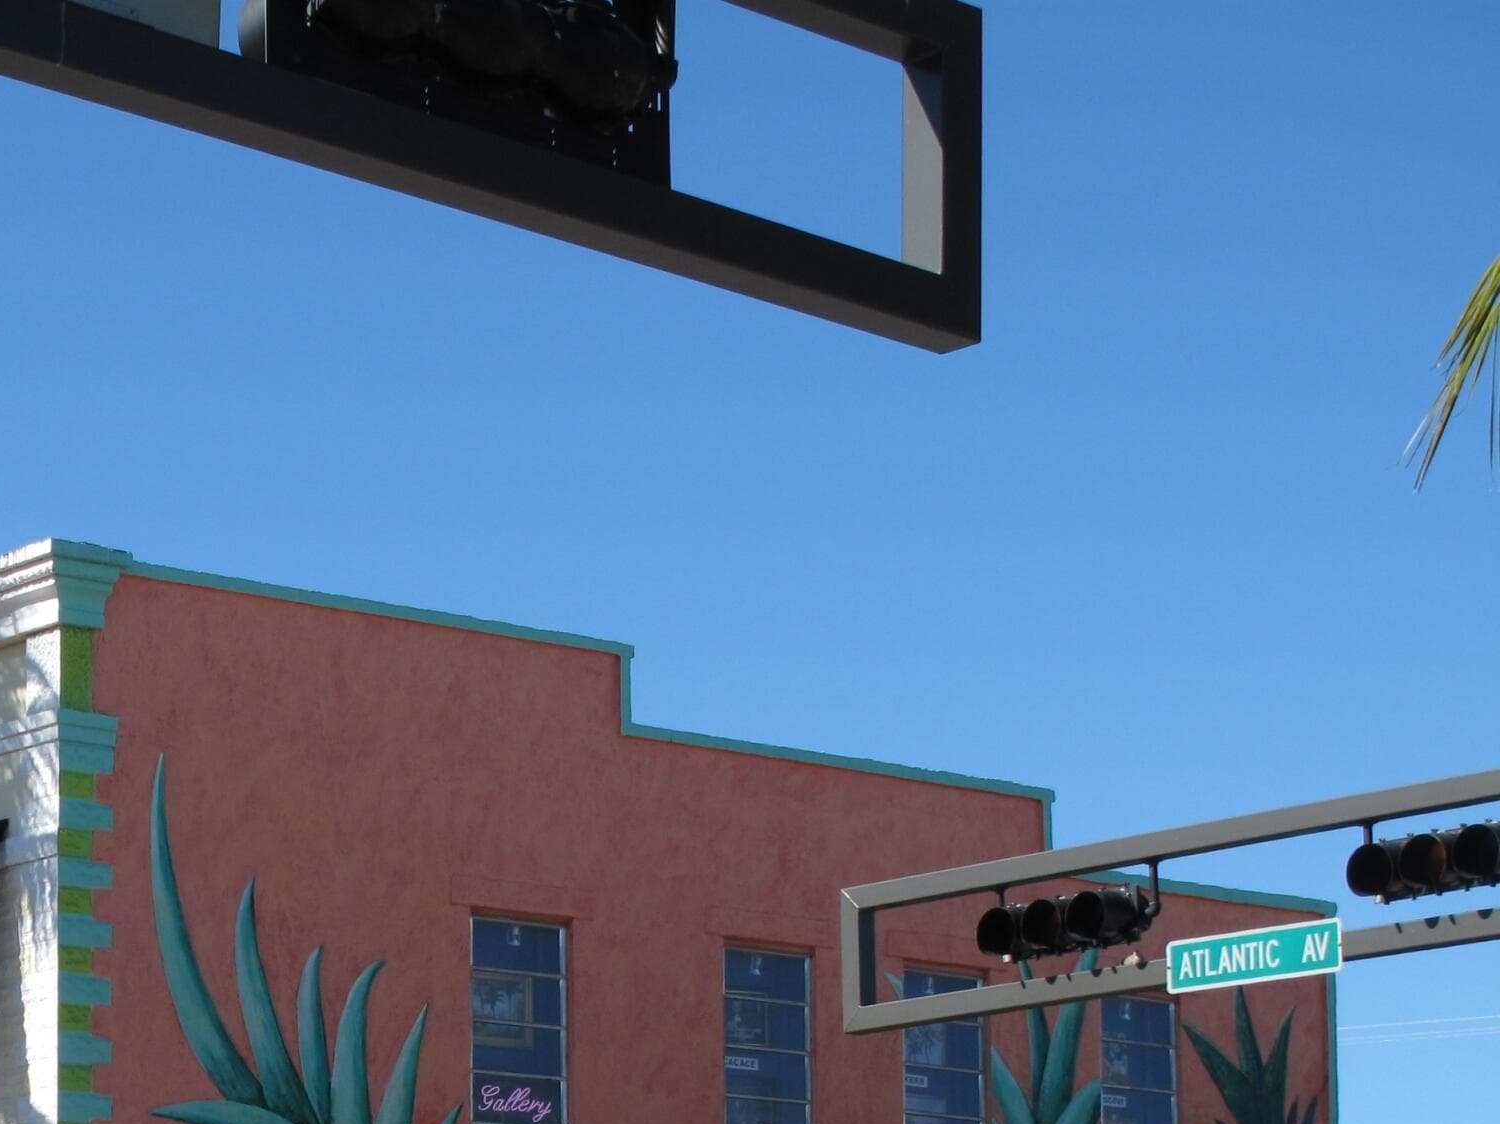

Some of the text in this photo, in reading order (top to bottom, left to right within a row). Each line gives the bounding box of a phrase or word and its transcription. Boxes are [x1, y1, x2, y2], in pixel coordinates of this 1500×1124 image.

[1178, 930, 1330, 981] ATLANTIC AV
[478, 1085, 552, 1122] Gallery
